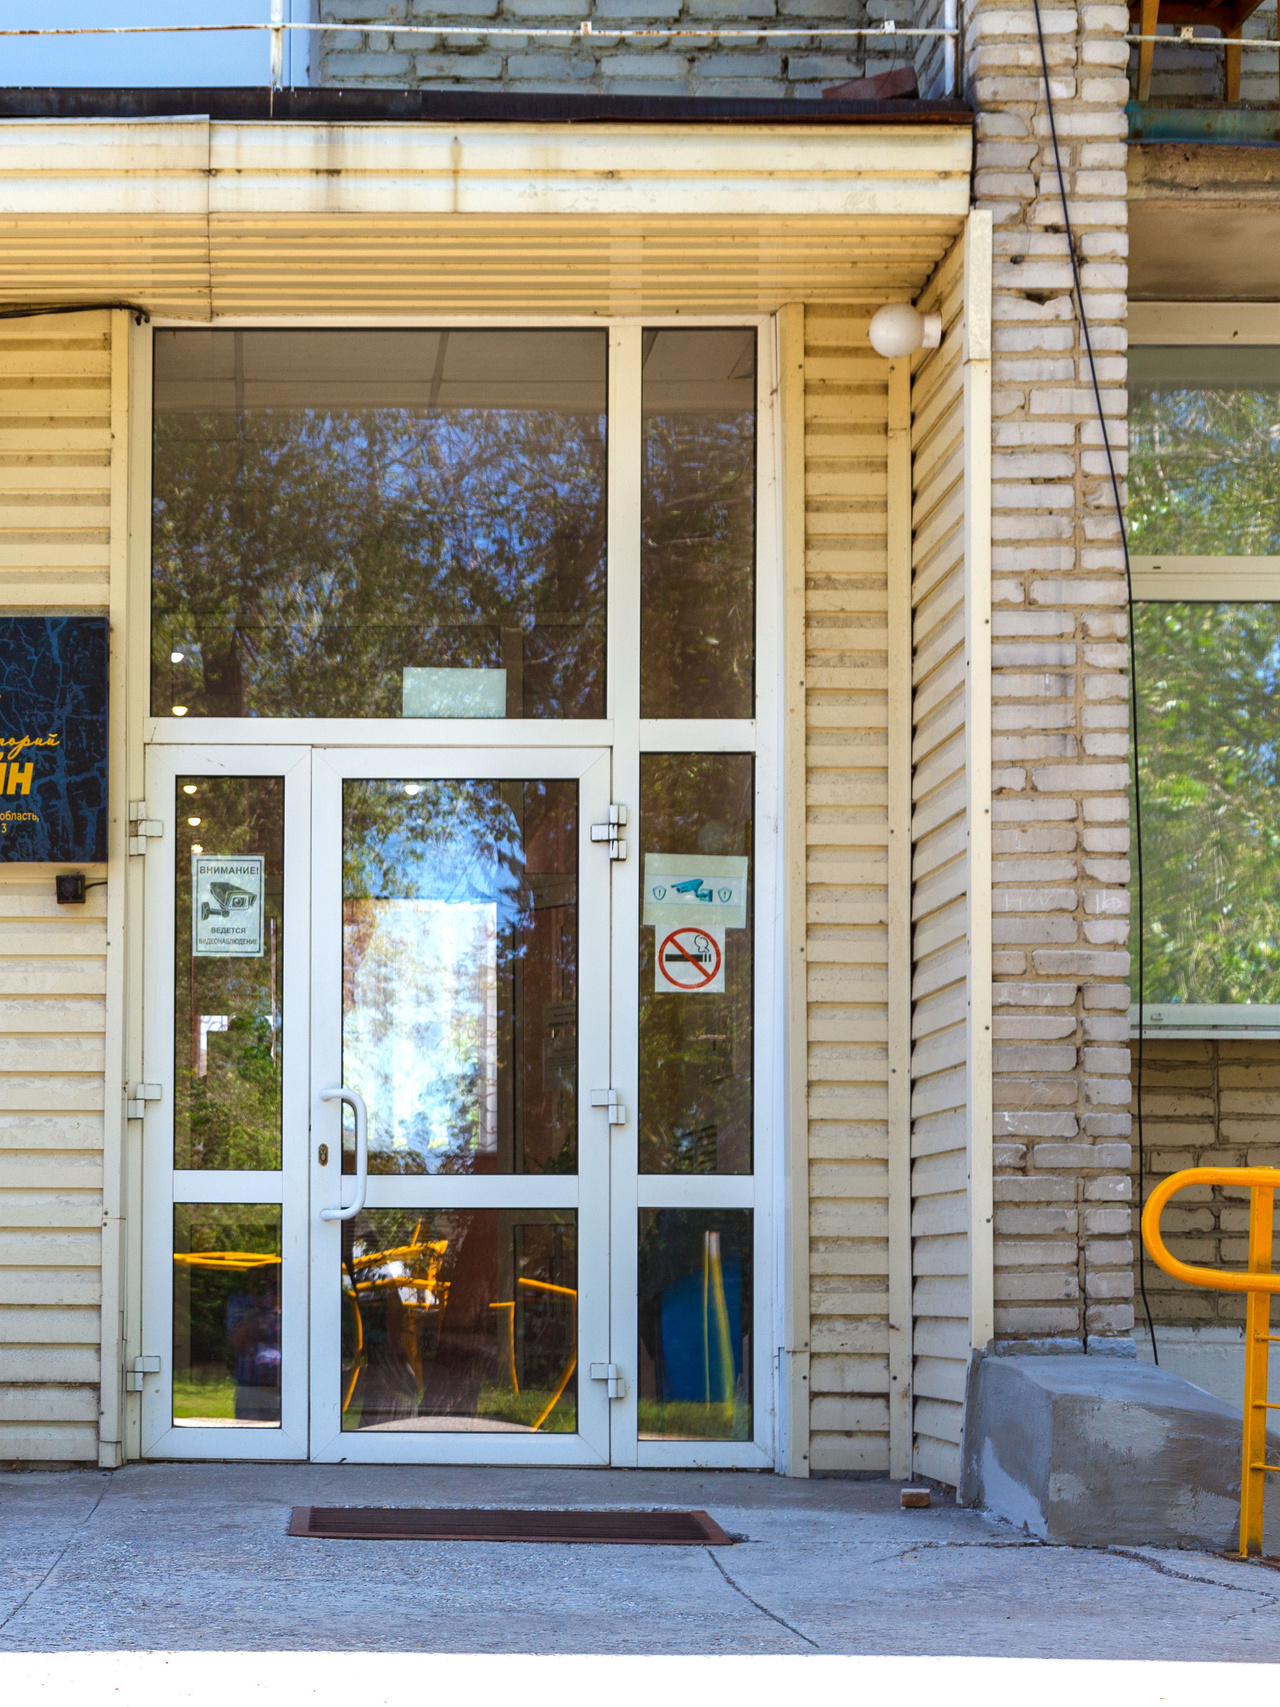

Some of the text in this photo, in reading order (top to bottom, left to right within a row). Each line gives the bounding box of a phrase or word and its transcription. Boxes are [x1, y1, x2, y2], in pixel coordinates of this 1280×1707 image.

[0, 810, 40, 823] область,
[1, 822, 8, 834] 3
[199, 865, 259, 875] ВНИМАНИЕ!
[210, 926, 247, 935] ВЕДЕТСЯ
[198, 937, 258, 946] ВИДЕОНАБЛЮДЕНИЕ
